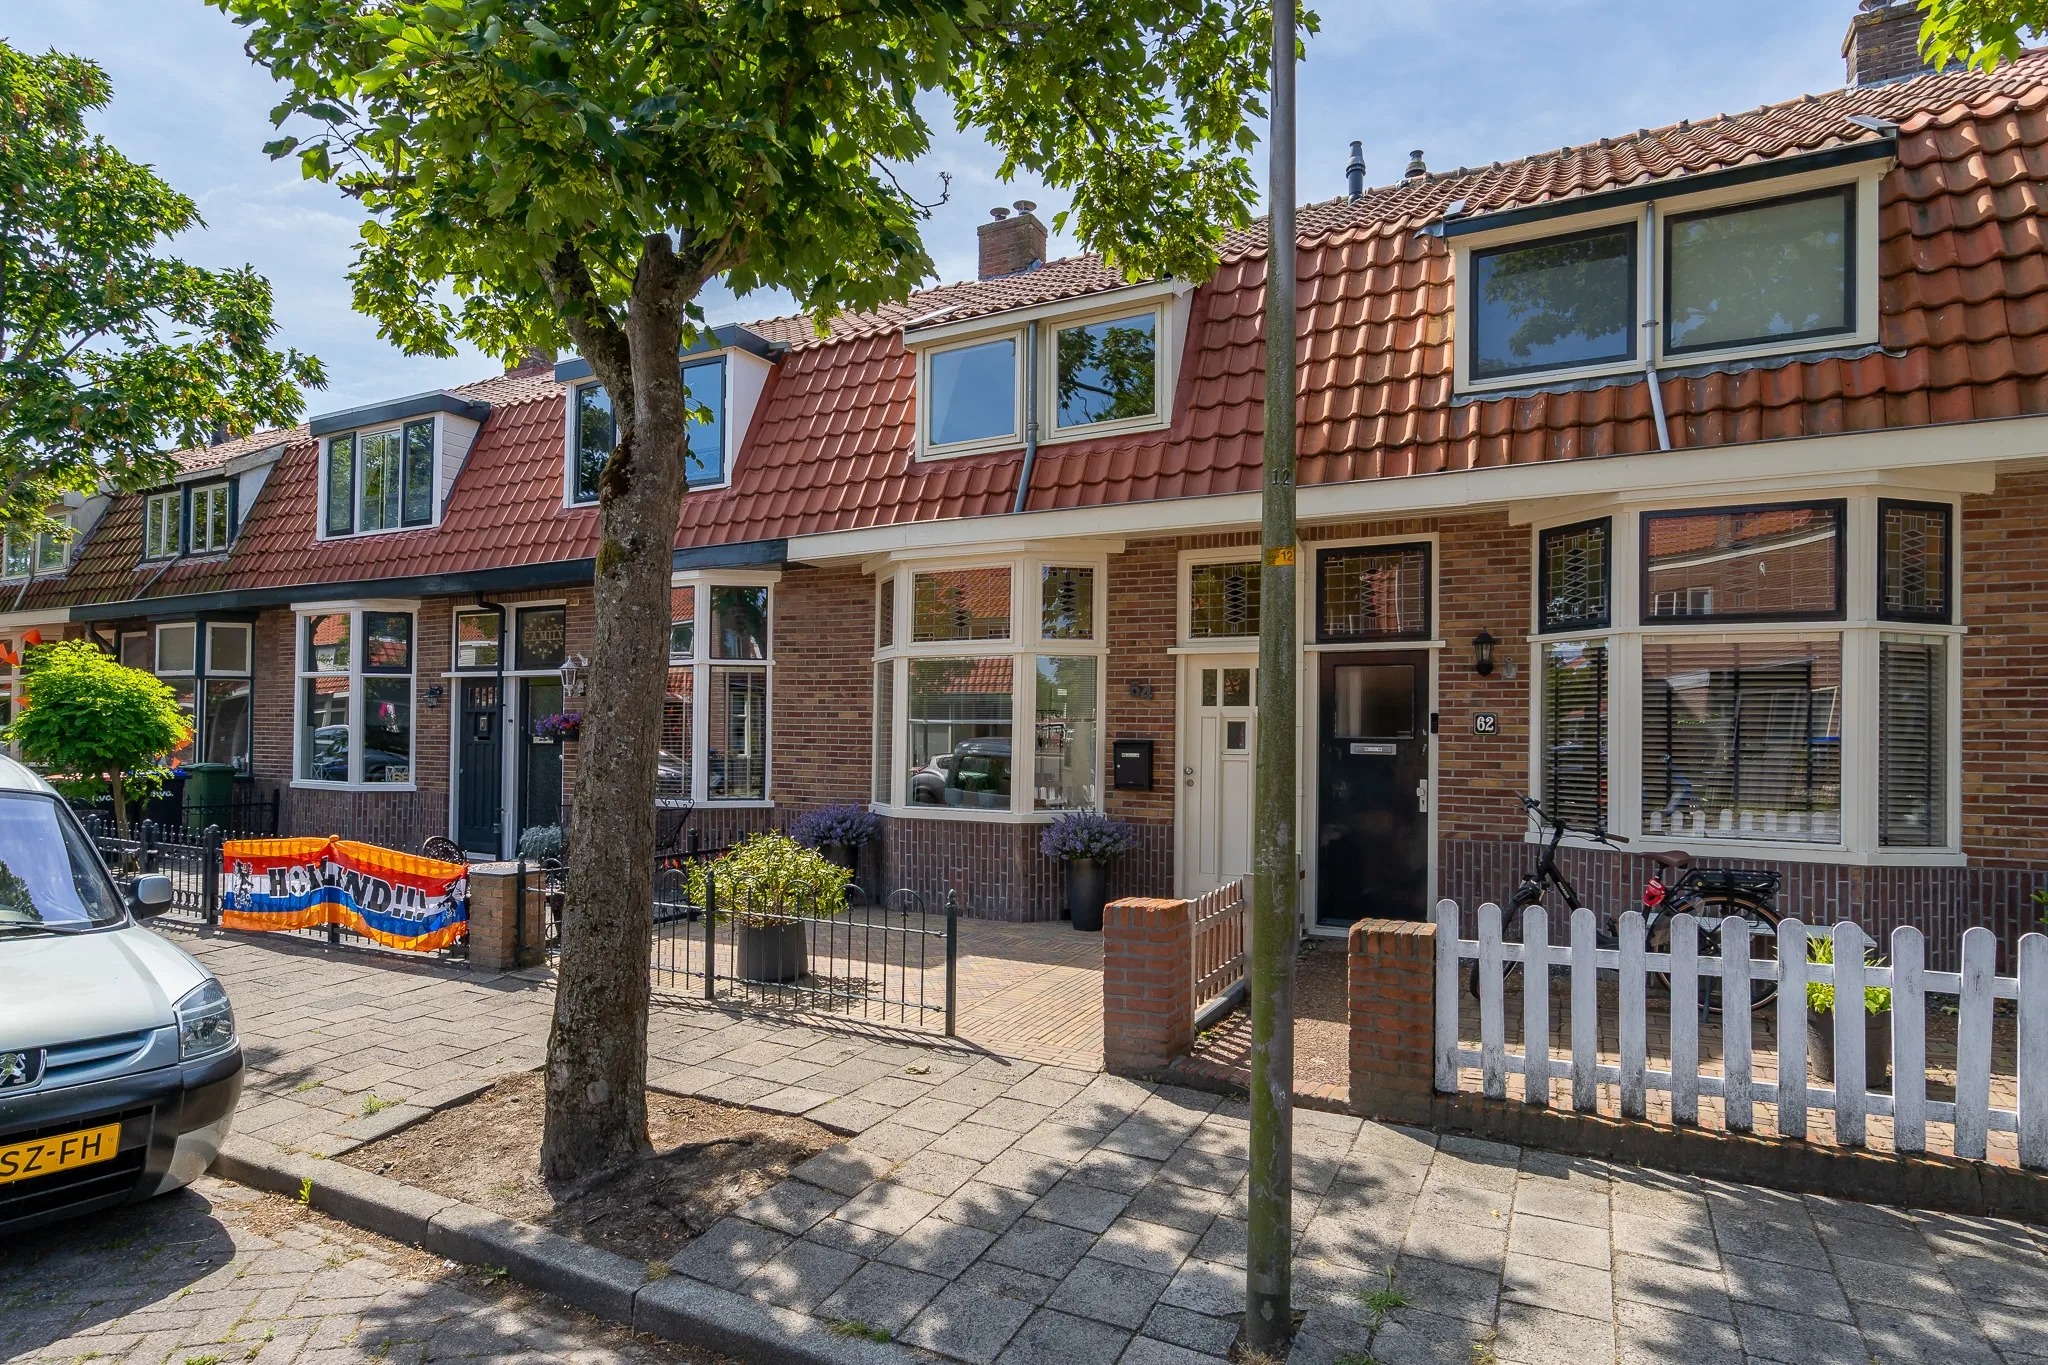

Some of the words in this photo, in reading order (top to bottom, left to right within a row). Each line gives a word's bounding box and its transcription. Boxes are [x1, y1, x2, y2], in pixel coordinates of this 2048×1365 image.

[1272, 468, 1290, 485] 12
[1280, 550, 1293, 562] 12
[525, 630, 563, 641] FAMILY
[1130, 680, 1152, 700] 64
[1476, 716, 1494, 732] 62
[0, 1133, 102, 1177] SZ-FH
